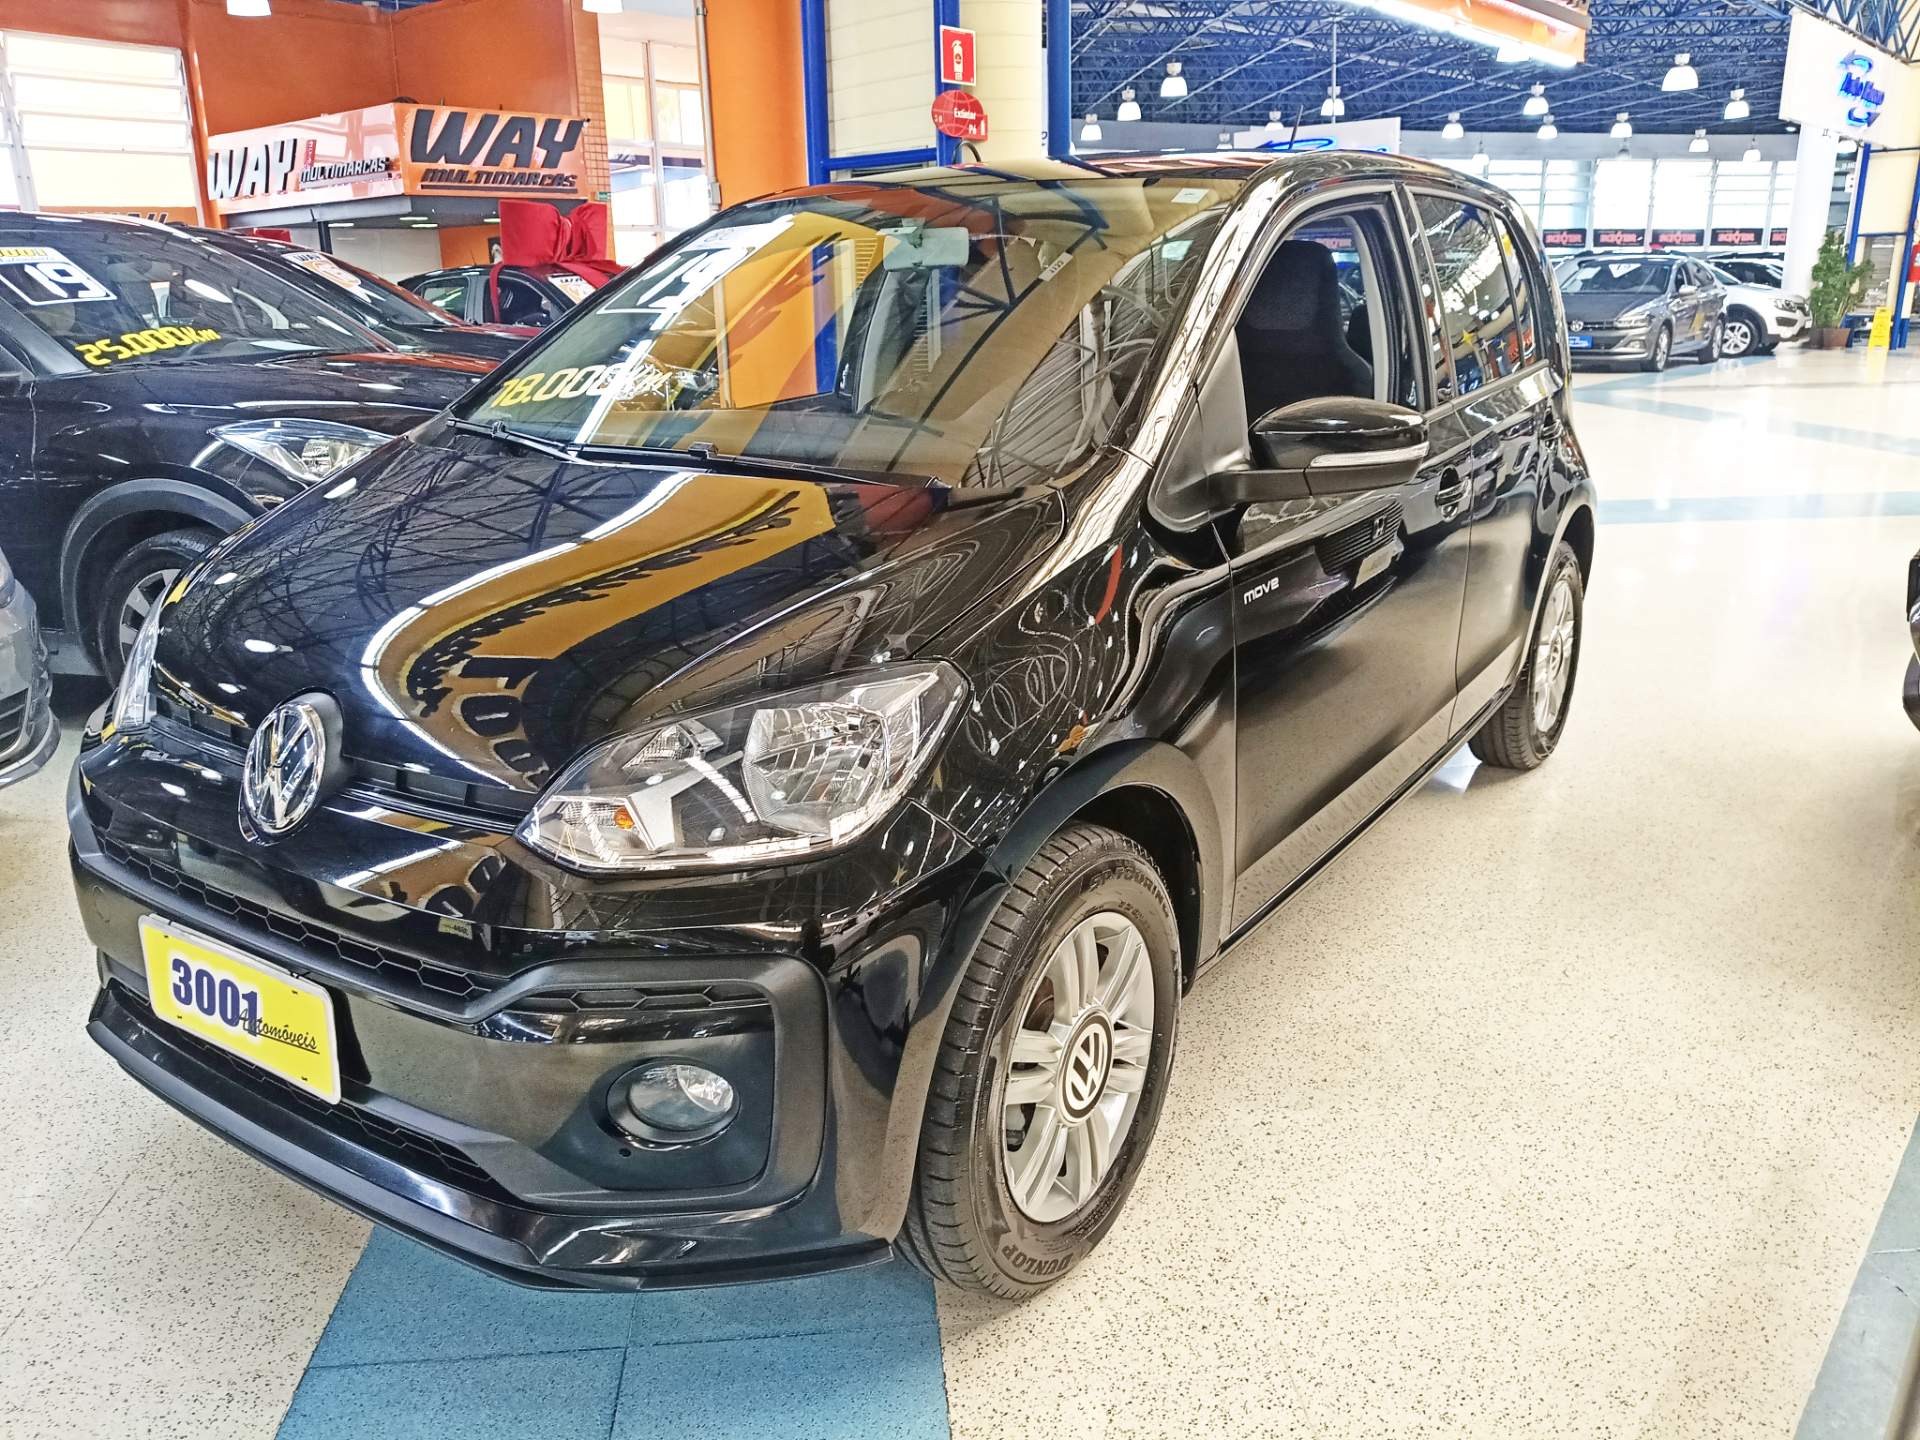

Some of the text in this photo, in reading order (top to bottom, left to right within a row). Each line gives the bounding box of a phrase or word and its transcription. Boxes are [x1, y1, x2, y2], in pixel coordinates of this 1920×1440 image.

[410, 108, 584, 169] WAY
[207, 138, 298, 199] WAY
[301, 157, 390, 183] MULTIMARCAS
[420, 167, 578, 187] MULTIMARCAS
[24, 262, 108, 298] 19
[172, 958, 258, 1036] 3001
[1001, 1243, 1074, 1276] DUNLOP
